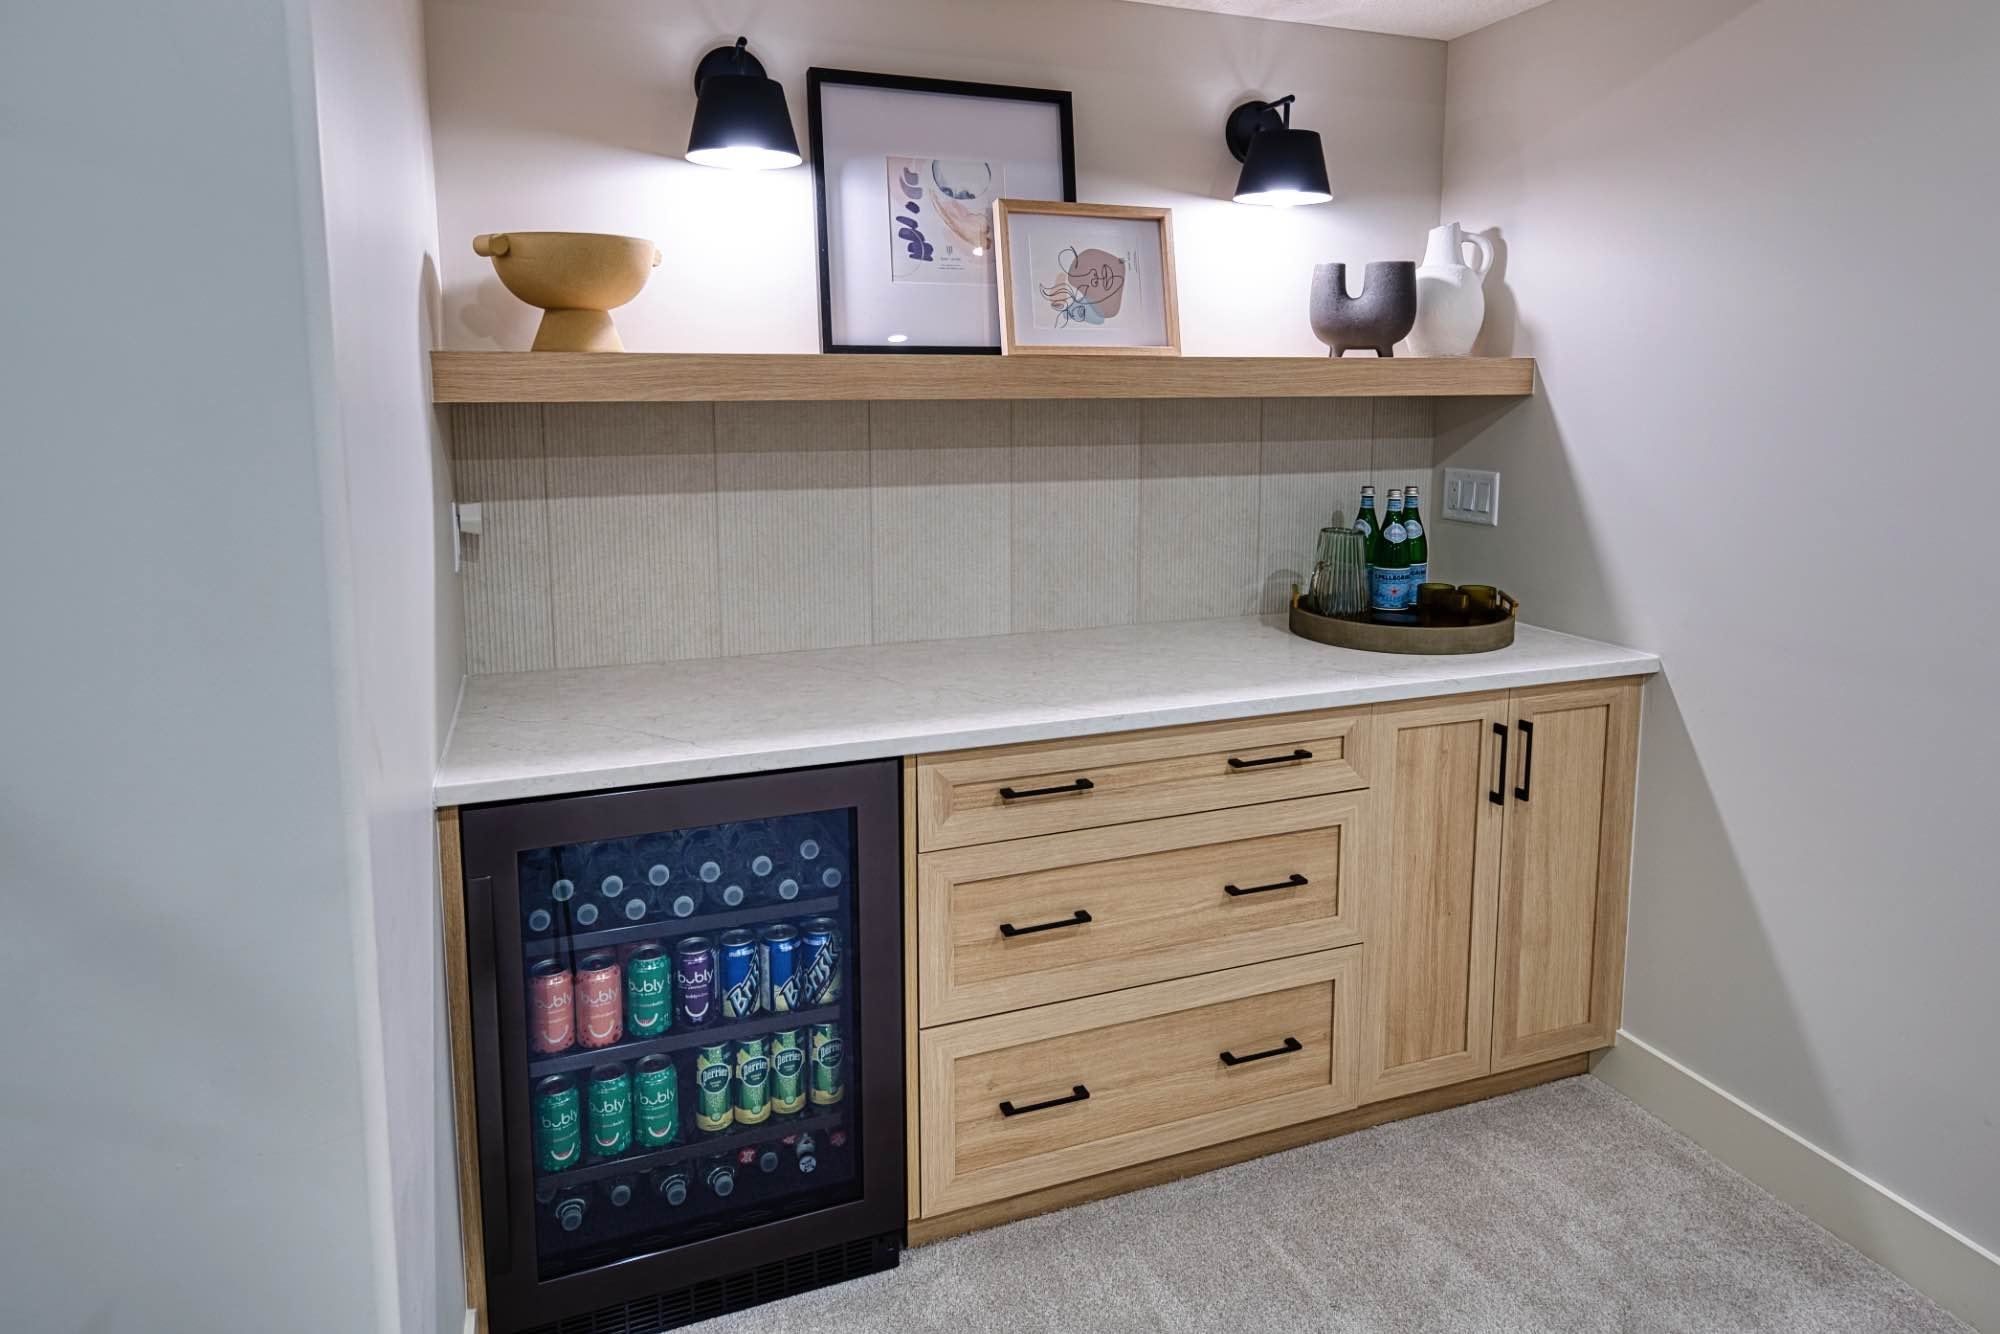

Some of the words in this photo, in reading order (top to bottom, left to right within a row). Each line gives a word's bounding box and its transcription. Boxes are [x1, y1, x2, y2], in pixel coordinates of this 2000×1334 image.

[677, 968, 714, 985] bubly
[580, 987, 617, 1005] bubly
[639, 1088, 676, 1106] bubly
[542, 1109, 578, 1128] bubly
